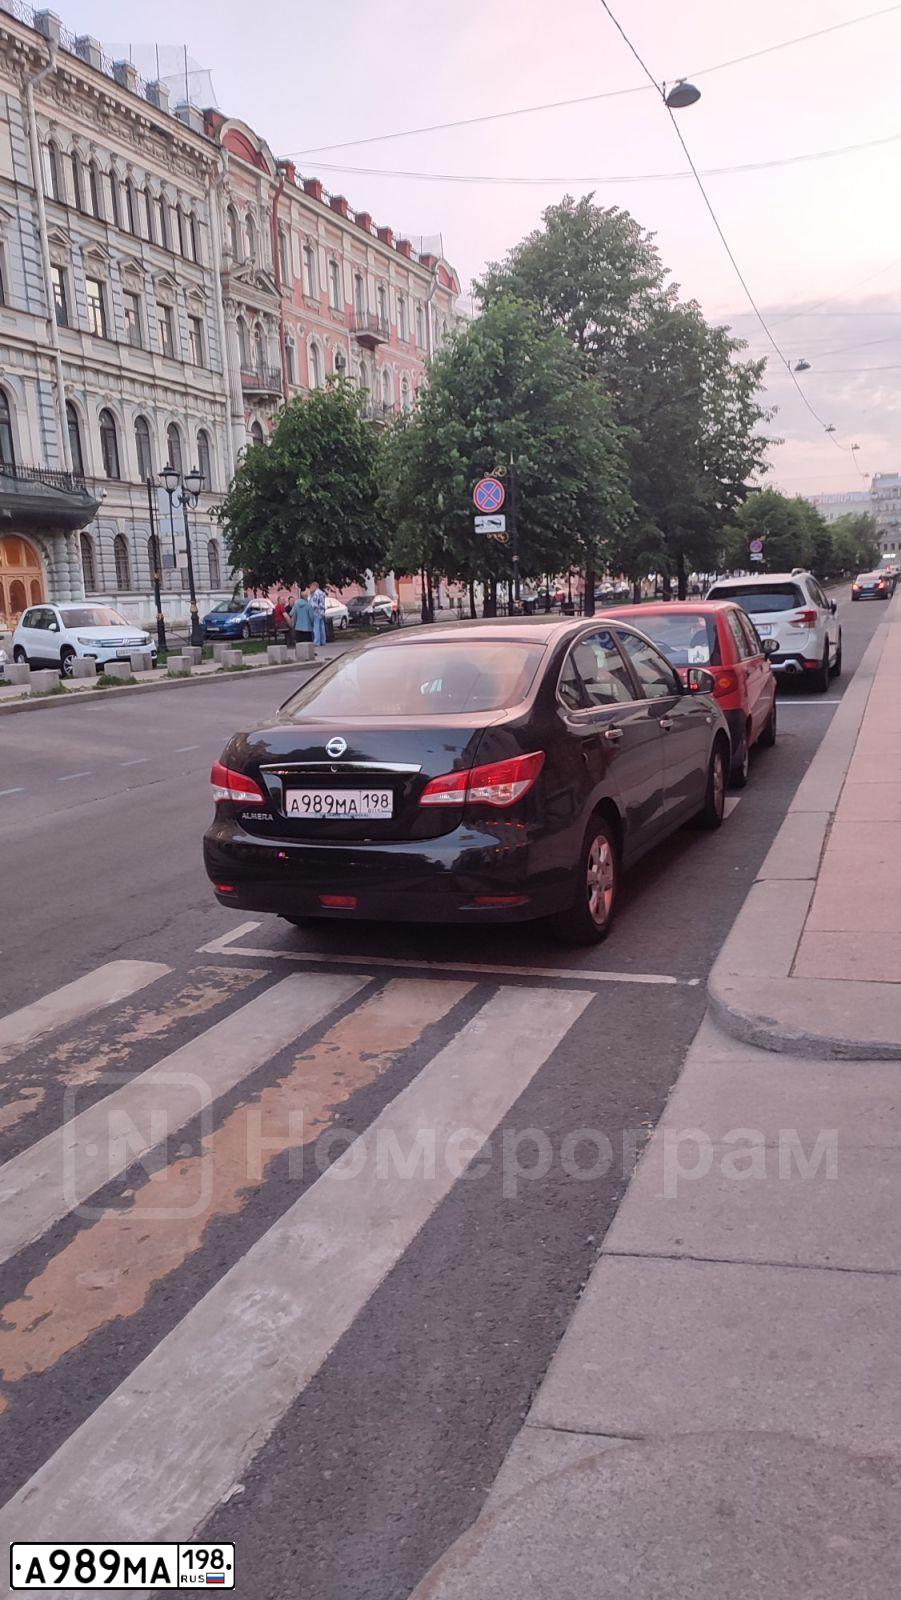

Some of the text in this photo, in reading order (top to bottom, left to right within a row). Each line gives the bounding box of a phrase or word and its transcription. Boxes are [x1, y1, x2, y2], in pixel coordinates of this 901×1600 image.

[291, 794, 389, 814] А989МА 198
[241, 812, 274, 821] ALMERA
